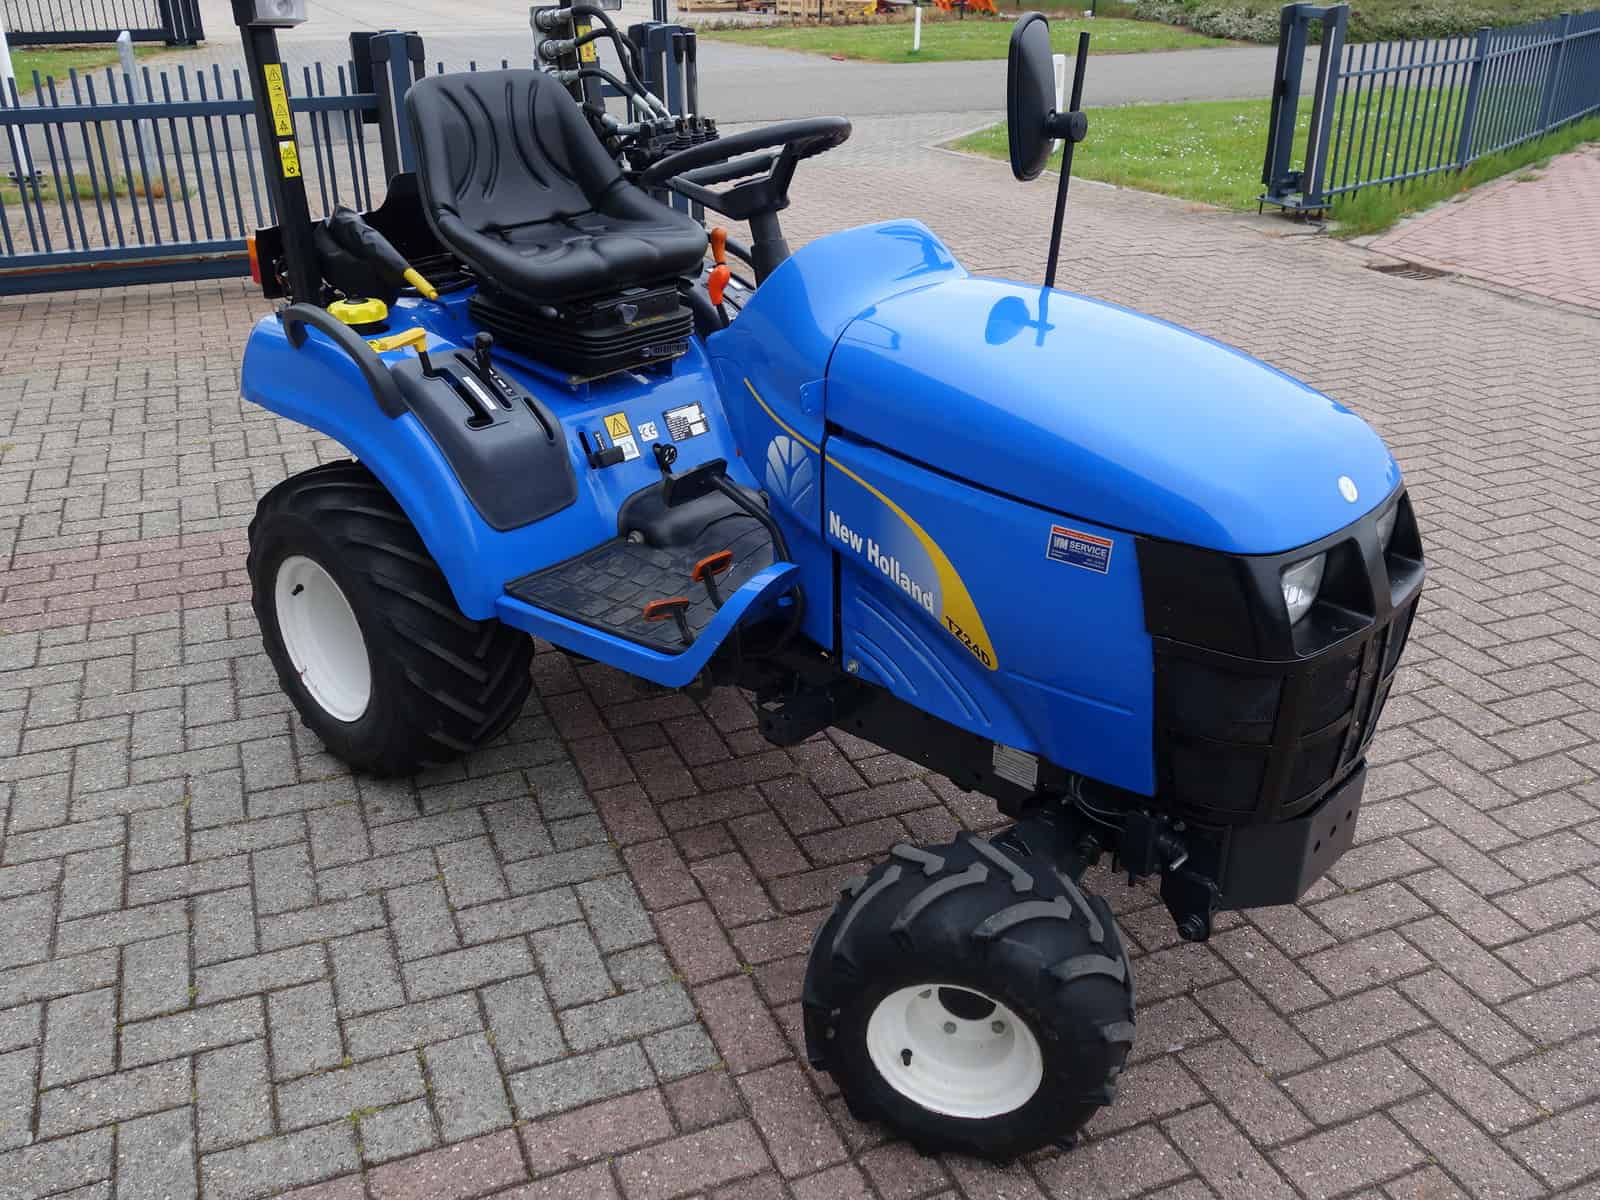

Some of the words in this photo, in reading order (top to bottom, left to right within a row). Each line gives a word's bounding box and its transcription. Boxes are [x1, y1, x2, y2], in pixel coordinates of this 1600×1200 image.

[829, 510, 863, 553] New
[867, 538, 934, 615] Holland
[1070, 540, 1108, 558] SERVICE
